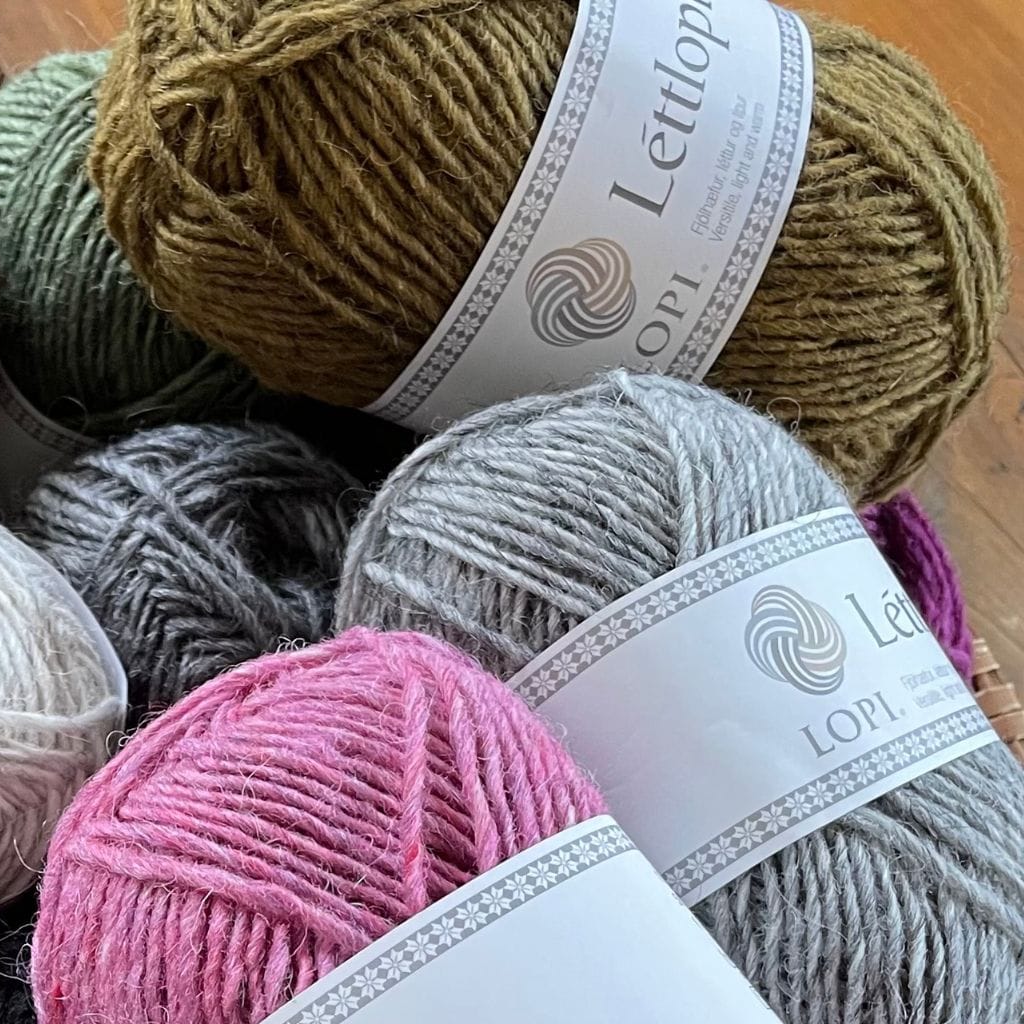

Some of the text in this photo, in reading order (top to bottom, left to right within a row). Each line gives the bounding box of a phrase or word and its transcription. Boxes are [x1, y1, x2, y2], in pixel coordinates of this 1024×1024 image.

[730, 120, 745, 137] og
[730, 161, 751, 190] light
[744, 134, 759, 161] and
[621, 270, 703, 372] OPI
[798, 691, 899, 758] LOPI
